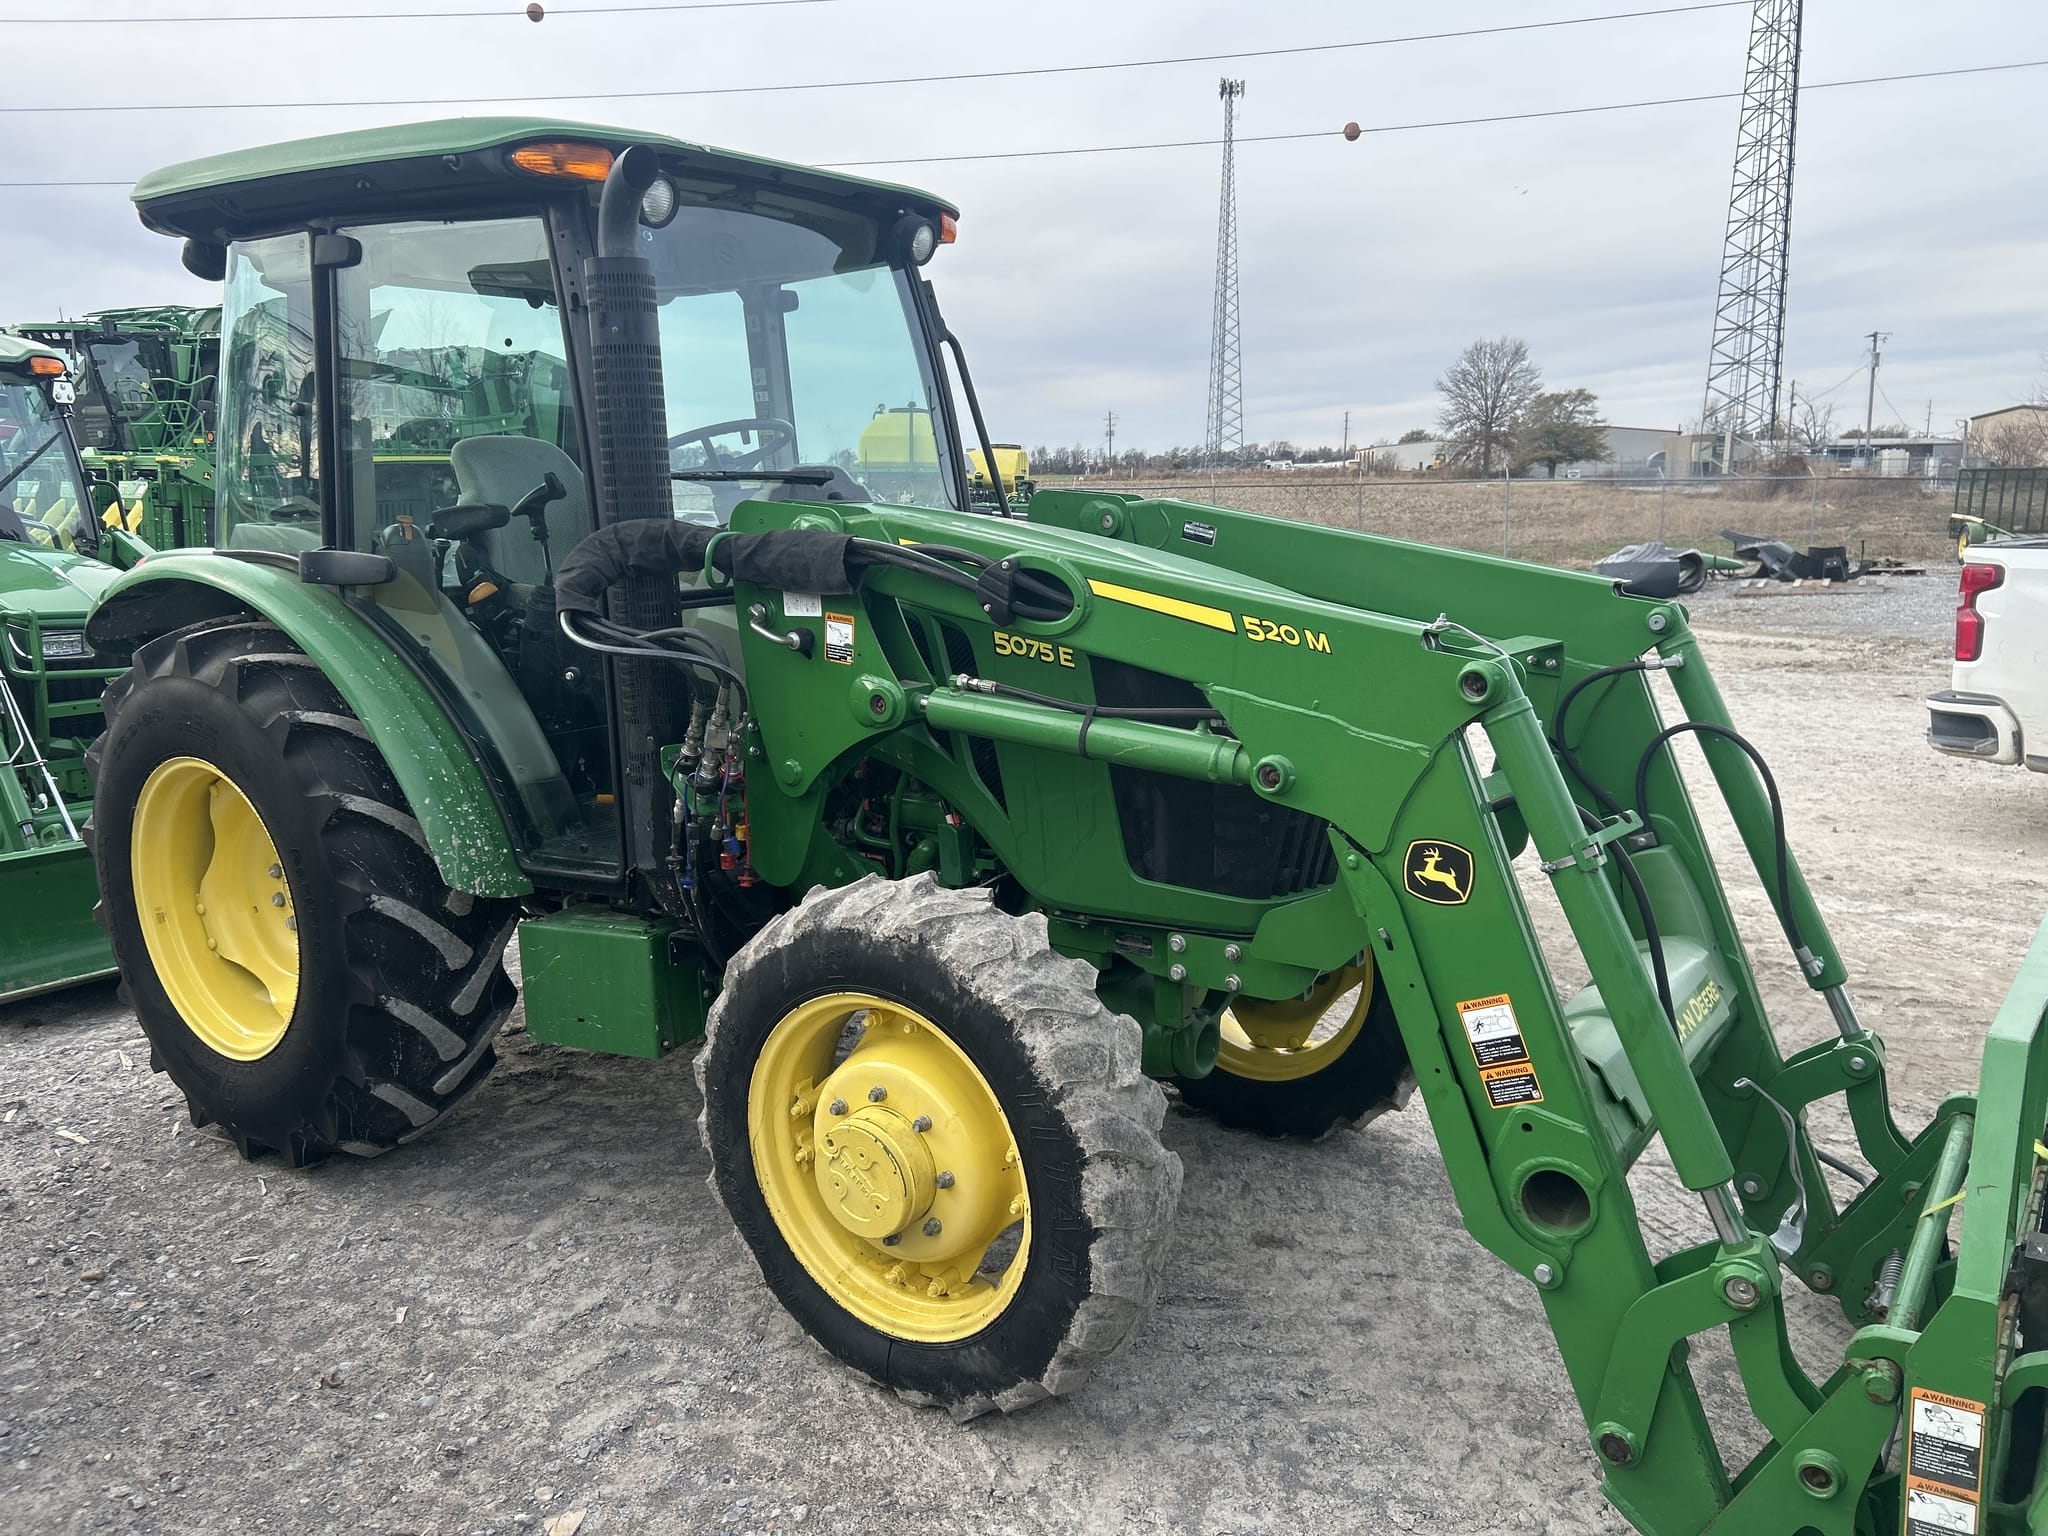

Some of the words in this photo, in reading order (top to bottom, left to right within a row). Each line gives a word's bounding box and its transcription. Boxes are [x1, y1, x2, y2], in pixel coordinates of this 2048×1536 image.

[1241, 615, 1301, 646] 520
[1303, 629, 1332, 654] M
[993, 630, 1055, 663] 5075
[1058, 646, 1076, 669] E
[1471, 997, 1504, 1009] WARNING
[1688, 980, 1720, 1023] DEERE
[1494, 1067, 1529, 1078] WARNING
[1929, 1392, 1976, 1411] WARNING
